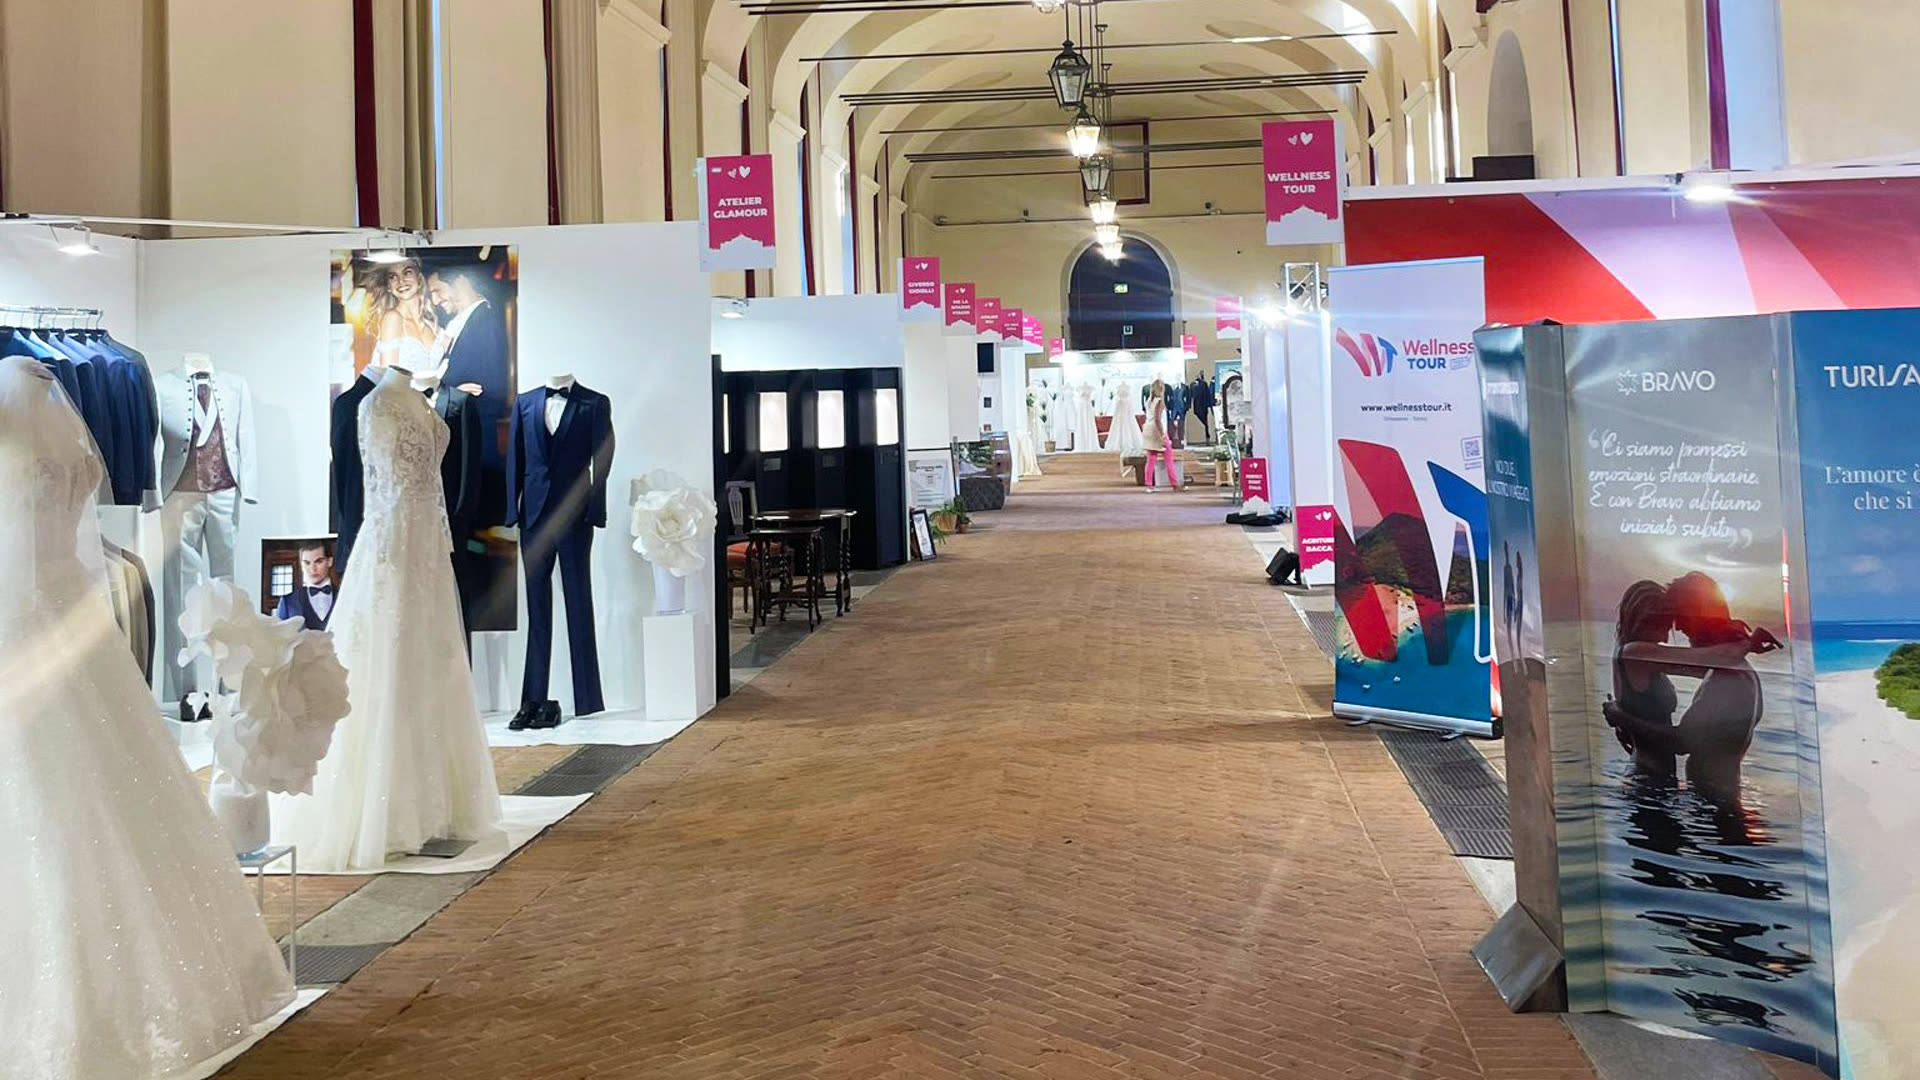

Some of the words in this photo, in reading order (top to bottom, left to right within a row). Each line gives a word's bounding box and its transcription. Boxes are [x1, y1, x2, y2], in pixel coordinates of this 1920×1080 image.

[1267, 171, 1331, 182] WELLNESS
[1282, 184, 1316, 194] TOUR
[718, 196, 762, 207] ATELIER
[713, 208, 768, 219] GLAMOUR
[1403, 339, 1475, 356] Wellness
[1407, 357, 1446, 370] TOUR
[1641, 370, 1716, 393] BRAVO
[1361, 402, 1453, 412] www.wellnesstour.it
[1626, 441, 1675, 458] siamo
[1677, 441, 1750, 468] promessi
[1588, 467, 1656, 483] emozioni
[1659, 459, 1760, 485] straordinarie.
[1825, 465, 1907, 484] L'amore
[1608, 496, 1633, 508] con
[1633, 482, 1684, 509] Bravo
[1688, 487, 1762, 512] abbiamo
[1853, 490, 1889, 510] che
[1895, 490, 1914, 509] si
[1620, 514, 1677, 537] iniziato
[1305, 545, 1334, 553] BACCA
